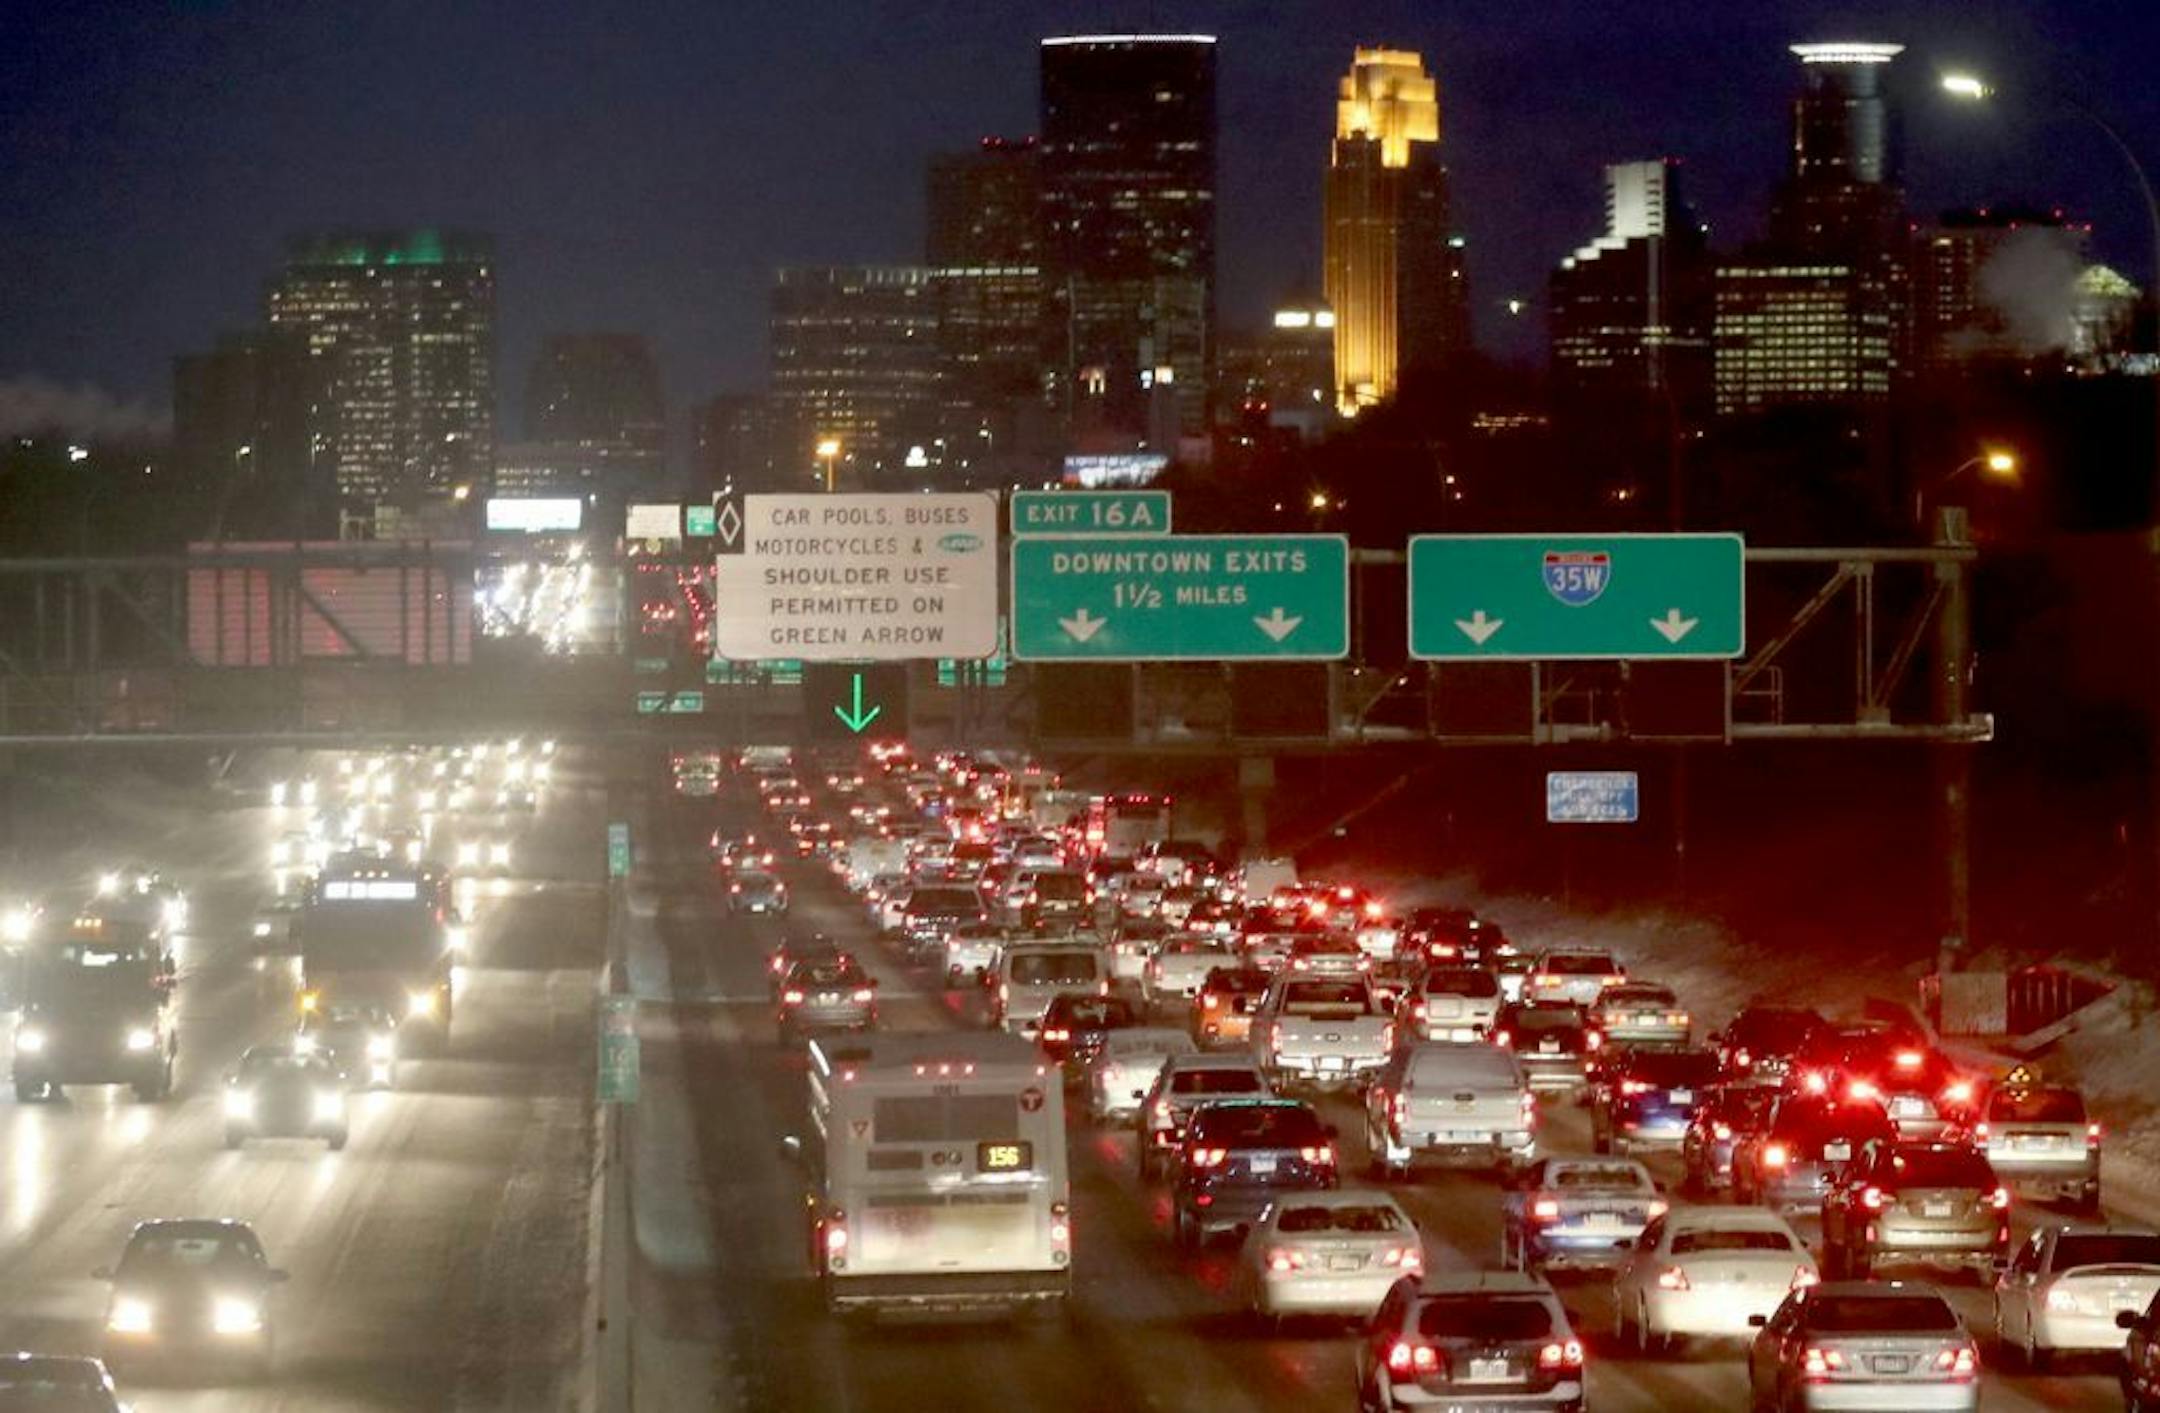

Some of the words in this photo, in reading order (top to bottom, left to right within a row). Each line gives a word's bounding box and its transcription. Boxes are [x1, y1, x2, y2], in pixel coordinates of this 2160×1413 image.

[771, 508, 810, 526] CAR
[905, 507, 969, 524] BUSES
[1028, 505, 1079, 522] EXIT
[1092, 502, 1152, 526] 16A
[756, 538, 898, 555] MOTORCYCLES
[913, 537, 923, 554] &
[1053, 552, 1211, 573] DOWNTOWN
[1226, 552, 1307, 572] EXITS
[765, 568, 891, 585] SHOULDER
[904, 568, 949, 584] USE
[1551, 566, 1602, 592] 35W
[1176, 586, 1247, 605] MILES
[771, 598, 898, 615] PERMITTED
[913, 598, 944, 614] ON
[771, 628, 847, 644] GREEN
[862, 628, 944, 643] ARROW
